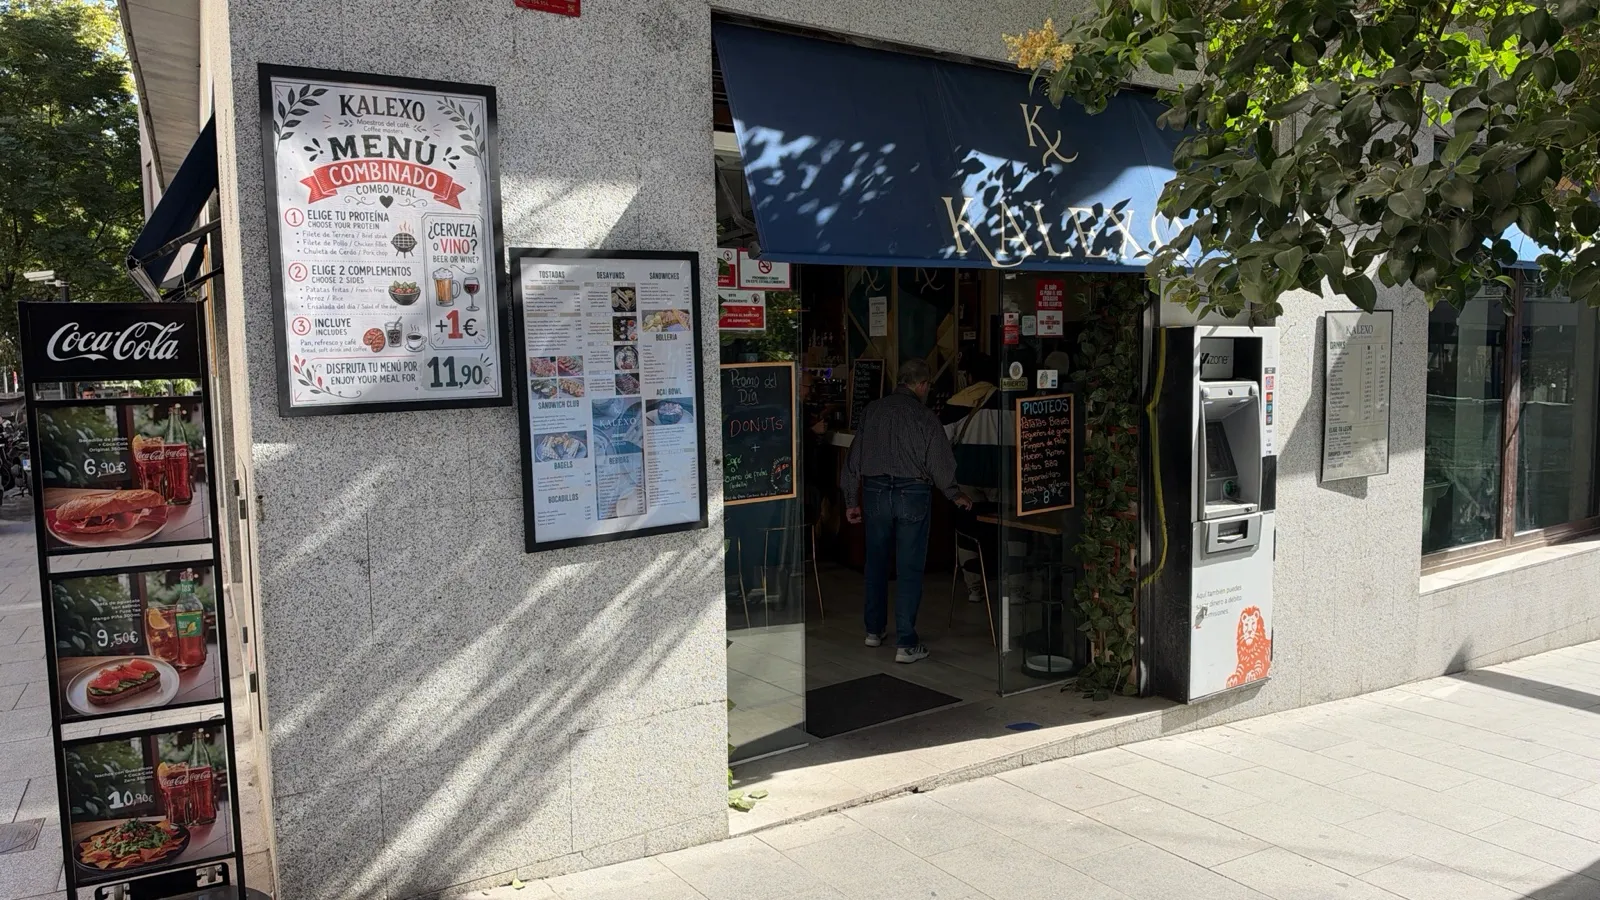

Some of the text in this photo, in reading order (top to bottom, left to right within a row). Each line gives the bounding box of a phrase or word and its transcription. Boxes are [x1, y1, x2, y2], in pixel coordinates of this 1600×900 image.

[339, 95, 425, 122] KALEXO
[328, 135, 438, 166] MENÚ
[329, 161, 437, 190] COMBINADO
[356, 184, 417, 198] COMBO MEAL
[291, 212, 297, 223] 1
[307, 210, 390, 222] ELIGE TU PROTEÍNA
[308, 221, 333, 229] CHOOSE
[353, 222, 380, 230] PROTEIN
[440, 239, 478, 255] VINO?
[460, 256, 480, 264] WINE?
[294, 266, 301, 278] 2
[312, 265, 412, 276] ELIGE 2 COMPLEMENTOS
[539, 270, 566, 279] TOSTADAS
[312, 276, 337, 284] CHOOSE
[298, 320, 306, 333] 3
[315, 318, 351, 328] INCLUYE
[315, 328, 348, 336] INCLUDES
[1346, 325, 1374, 337] KALEXO
[47, 321, 185, 362] Coca-Cola
[326, 360, 418, 374] DISFRUTA TU MENÚ POR
[331, 373, 416, 385] ENJOY YOUR MEAL FOR
[730, 369, 777, 388] Promo del
[668, 387, 682, 395] BOWL
[538, 400, 580, 410] SANDWICH CLUB
[1022, 399, 1069, 415] PICOTEOS
[599, 417, 637, 429] KALEXO
[553, 461, 573, 470] BAGELS
[609, 456, 630, 465] BEBIDAS
[84, 458, 127, 477] 6,90€
[548, 494, 579, 504] BOCADILLOS
[97, 629, 138, 648] 9,50€
[107, 791, 153, 809] 10,90€
